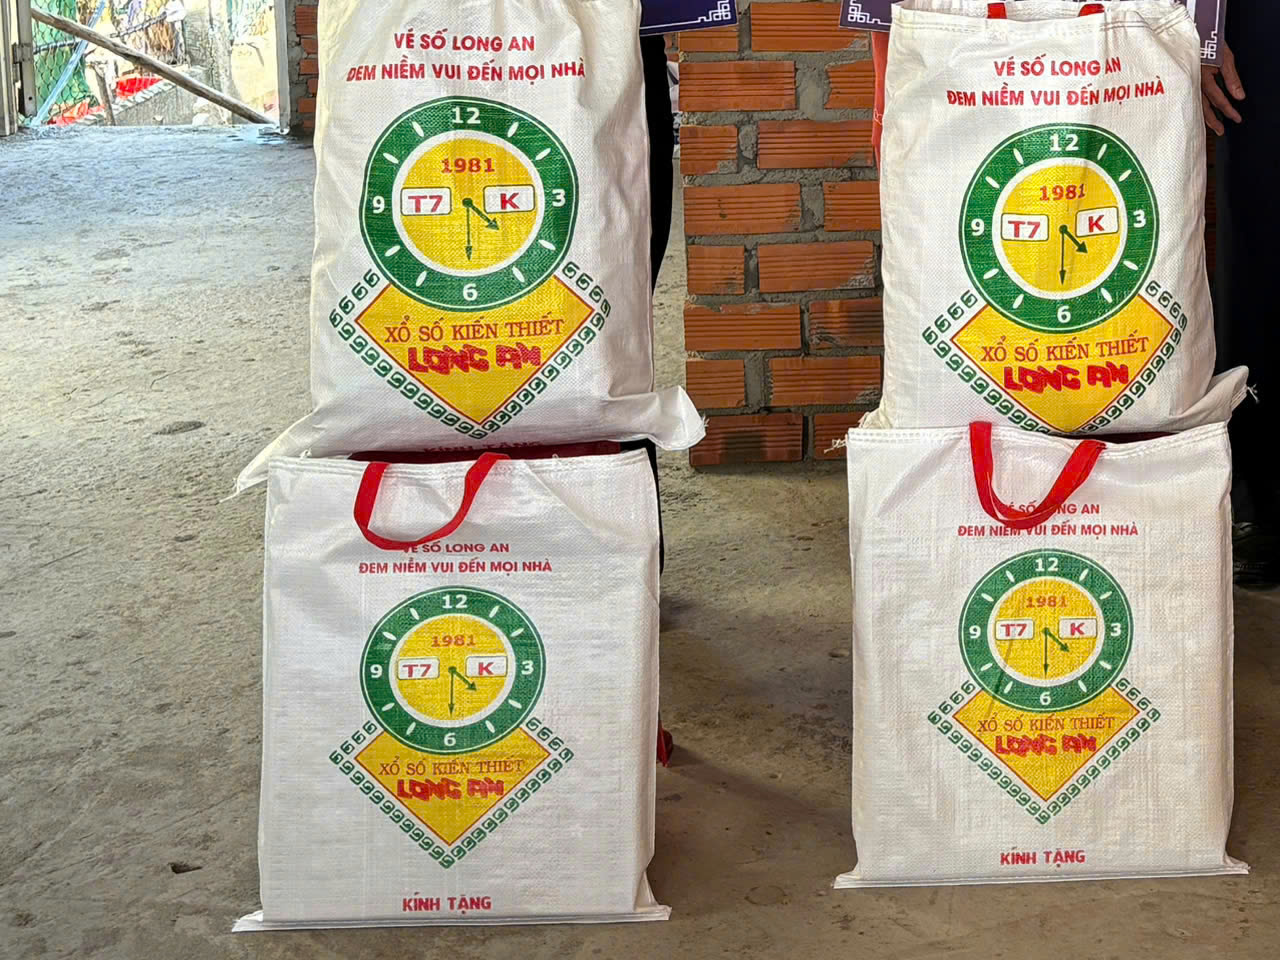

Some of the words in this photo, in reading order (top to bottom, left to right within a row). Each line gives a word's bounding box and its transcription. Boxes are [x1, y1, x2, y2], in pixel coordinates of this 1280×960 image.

[394, 29, 414, 48] VÉ
[420, 29, 447, 50] SỐ
[452, 36, 503, 52] LONG
[508, 36, 535, 51] AN
[382, 55, 425, 79] NIỀM
[432, 64, 460, 79] VUI
[468, 59, 502, 81] ĐẾN
[509, 63, 545, 85] MỌI
[551, 57, 585, 78] NHÀ
[994, 57, 1014, 76] VÉ
[1021, 54, 1046, 76] SỐ
[1051, 61, 1101, 76] LONG
[1105, 57, 1121, 75] AN
[947, 90, 976, 106] ĐEM
[982, 83, 1024, 106] NIỀM
[1030, 90, 1059, 105] VUI
[1067, 83, 1099, 105] ĐẾN
[1104, 85, 1130, 107] MỌI
[1135, 76, 1164, 97] NHÀ
[452, 108, 481, 124] 12
[1050, 134, 1078, 151] 12
[442, 158, 495, 173] 1981
[500, 193, 519, 210] K
[1039, 184, 1085, 200] 1981
[408, 195, 443, 212] T7
[1008, 221, 1041, 239] T7
[1088, 215, 1105, 233] K
[385, 315, 413, 343] XỔ
[418, 317, 443, 341] SỐ
[452, 317, 498, 339] KIẾN
[506, 312, 564, 337] THIẾT
[981, 336, 1006, 362] XỔ
[1015, 339, 1038, 362] SỐ
[1046, 337, 1089, 361] KIẾN
[1096, 330, 1149, 355] THIẾT
[408, 344, 489, 375] LONG
[496, 342, 541, 369] AN
[1004, 364, 1080, 393] LONG
[1087, 362, 1128, 387] AN
[359, 563, 388, 573] ĐEM
[431, 562, 453, 572] VUI
[458, 557, 485, 572] ĐẾN
[491, 562, 518, 576] MỌI
[522, 558, 552, 572] NHÀ
[1000, 847, 1036, 865] KÍNH
[403, 892, 440, 911] KÍNH
